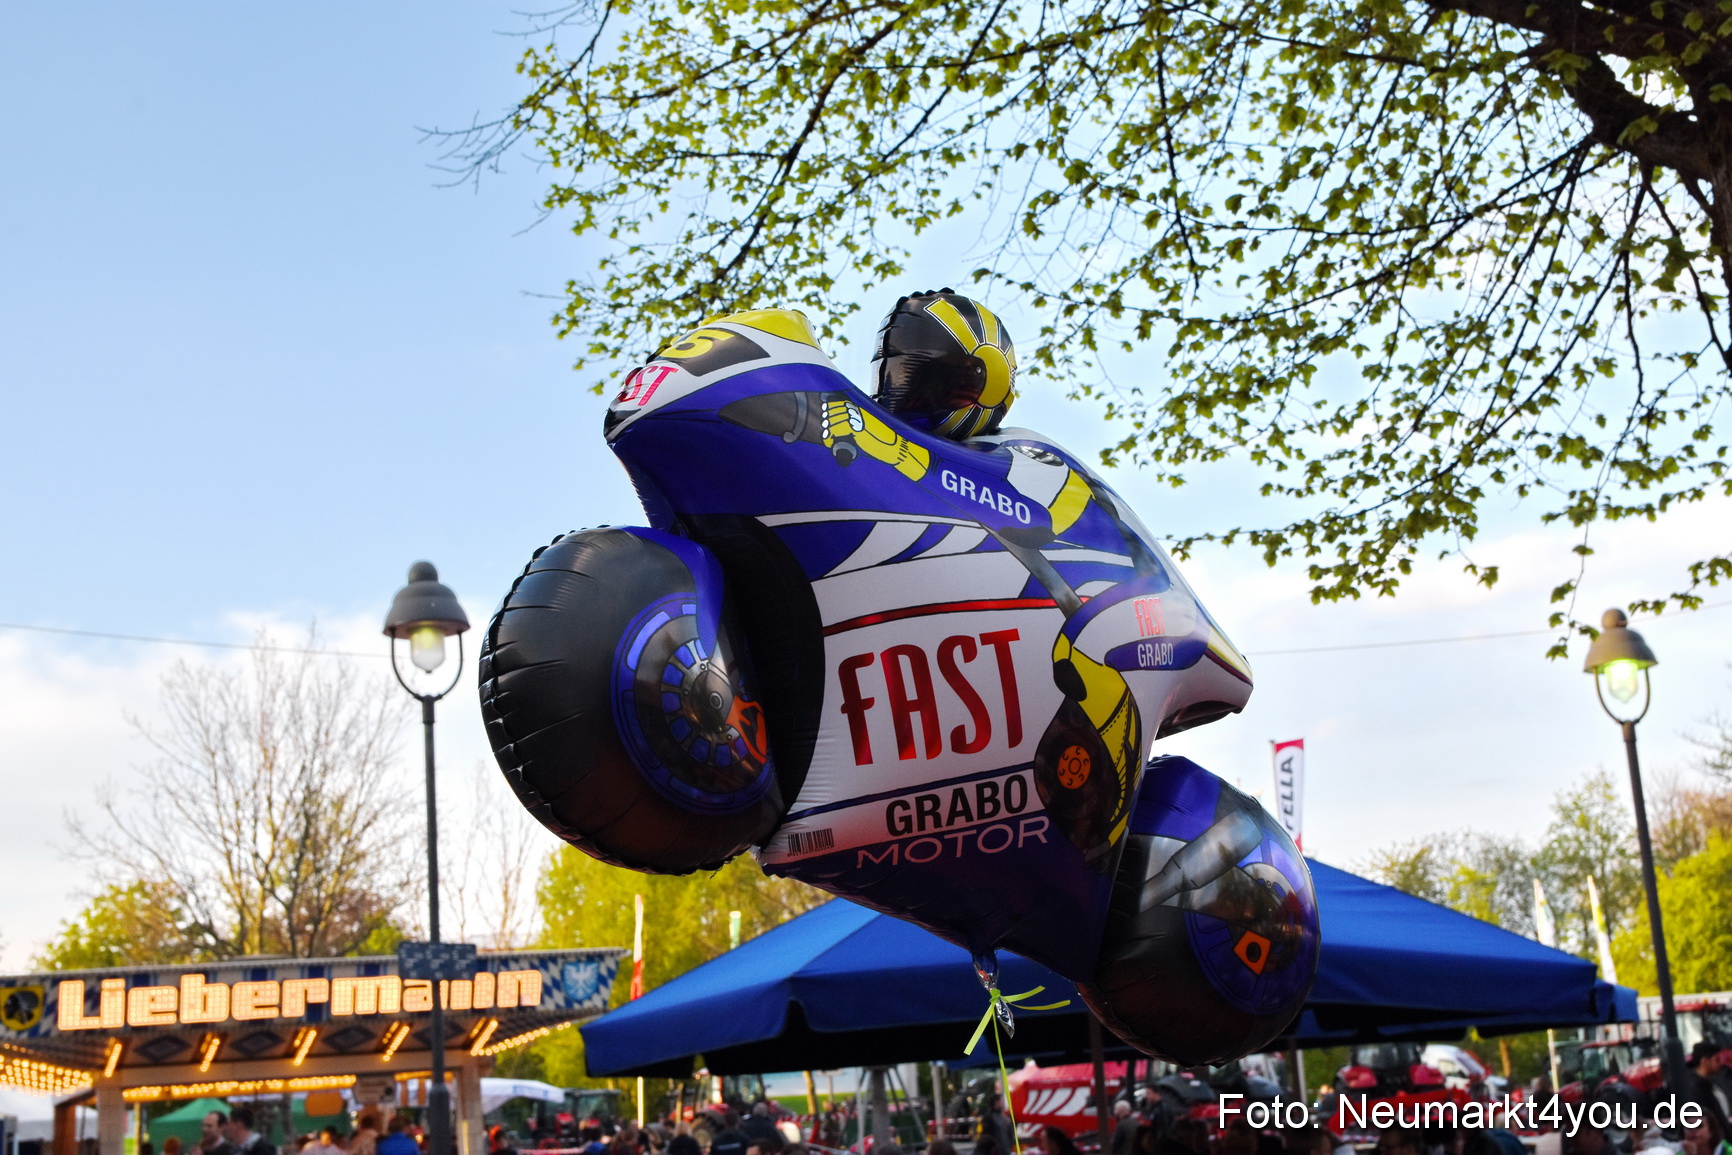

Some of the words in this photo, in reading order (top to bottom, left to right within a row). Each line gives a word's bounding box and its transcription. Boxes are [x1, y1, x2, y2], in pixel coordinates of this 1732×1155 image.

[941, 469, 1032, 525] GRABO
[1133, 597, 1166, 637] FAST
[1137, 643, 1174, 667] GRABO
[838, 628, 1023, 767] FAST
[885, 774, 1029, 837] GRABO
[856, 815, 1050, 869] MOTOR
[57, 969, 543, 1031] Liebermann
